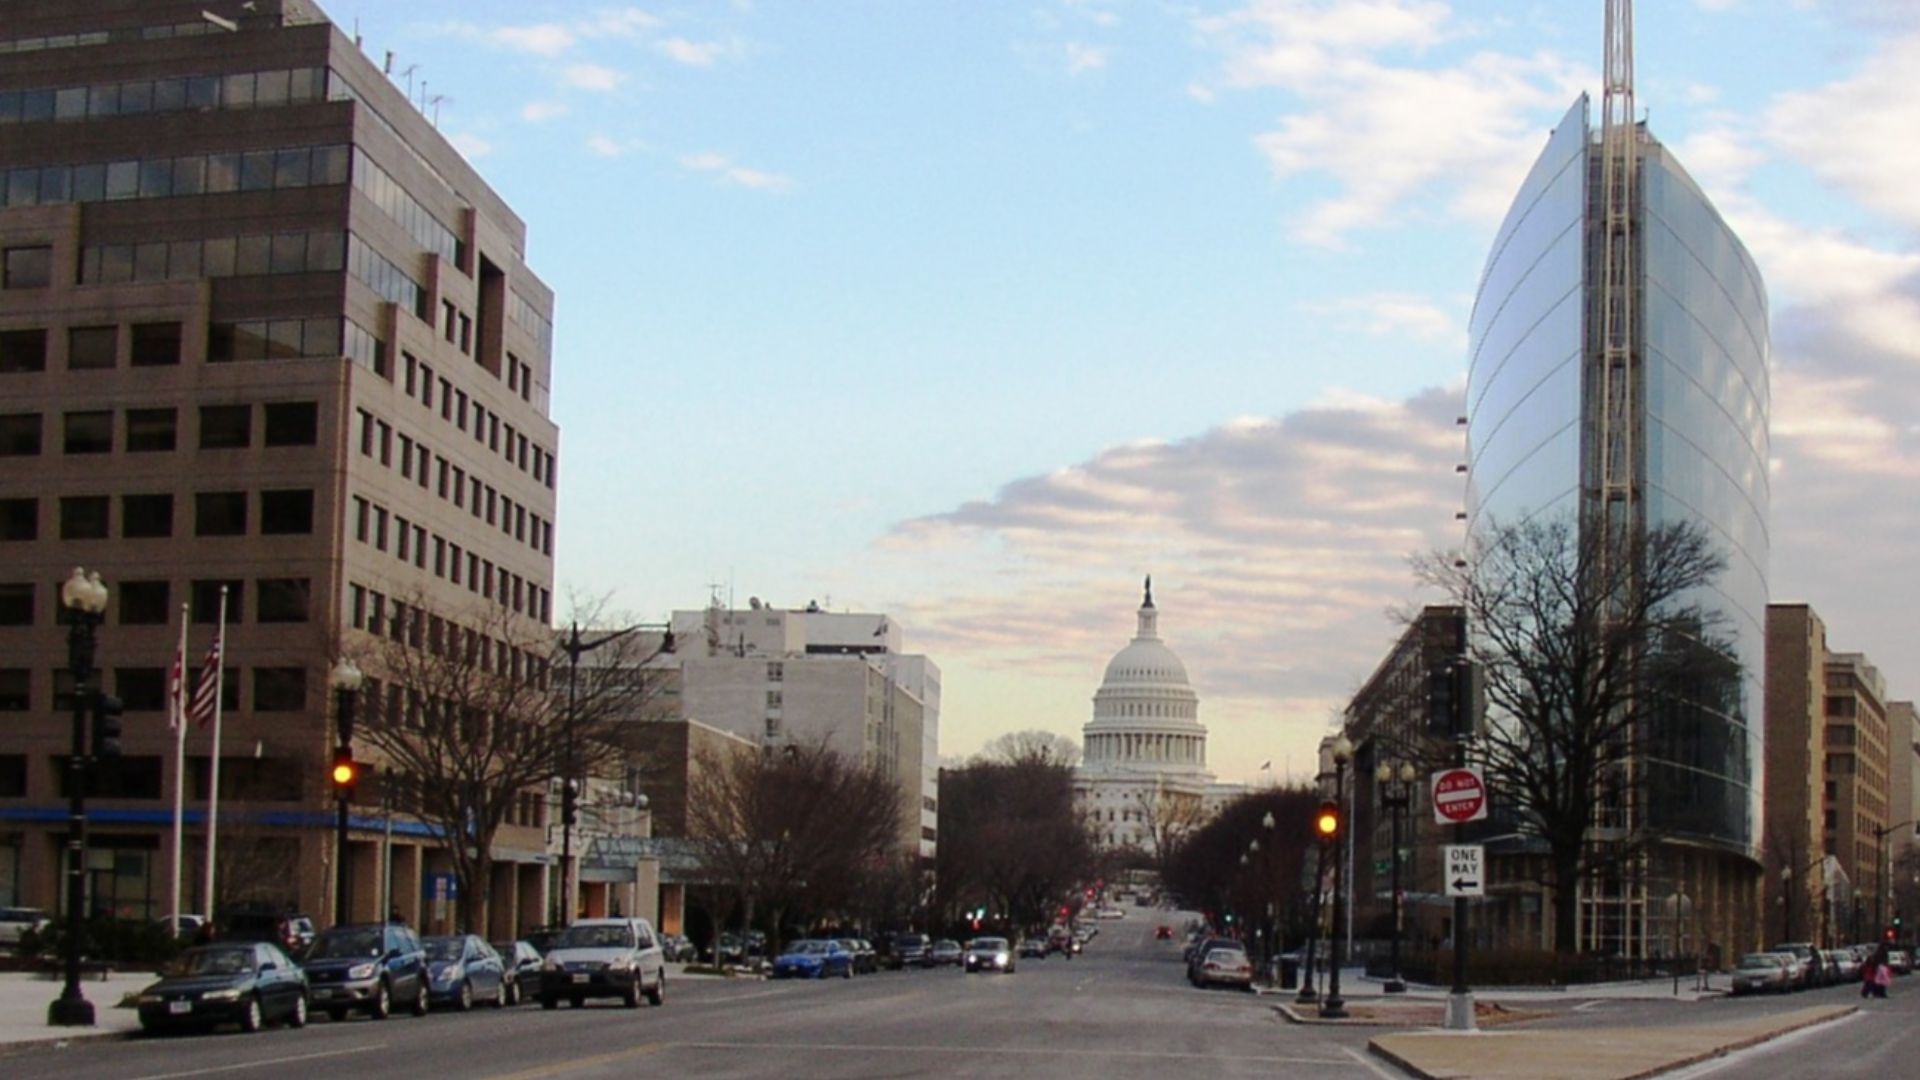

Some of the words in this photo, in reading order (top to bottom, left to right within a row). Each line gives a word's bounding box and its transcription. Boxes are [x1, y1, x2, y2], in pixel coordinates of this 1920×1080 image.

[1445, 801, 1474, 813] ENTER
[1451, 849, 1477, 861] ONE
[1451, 863, 1478, 875] WAY
